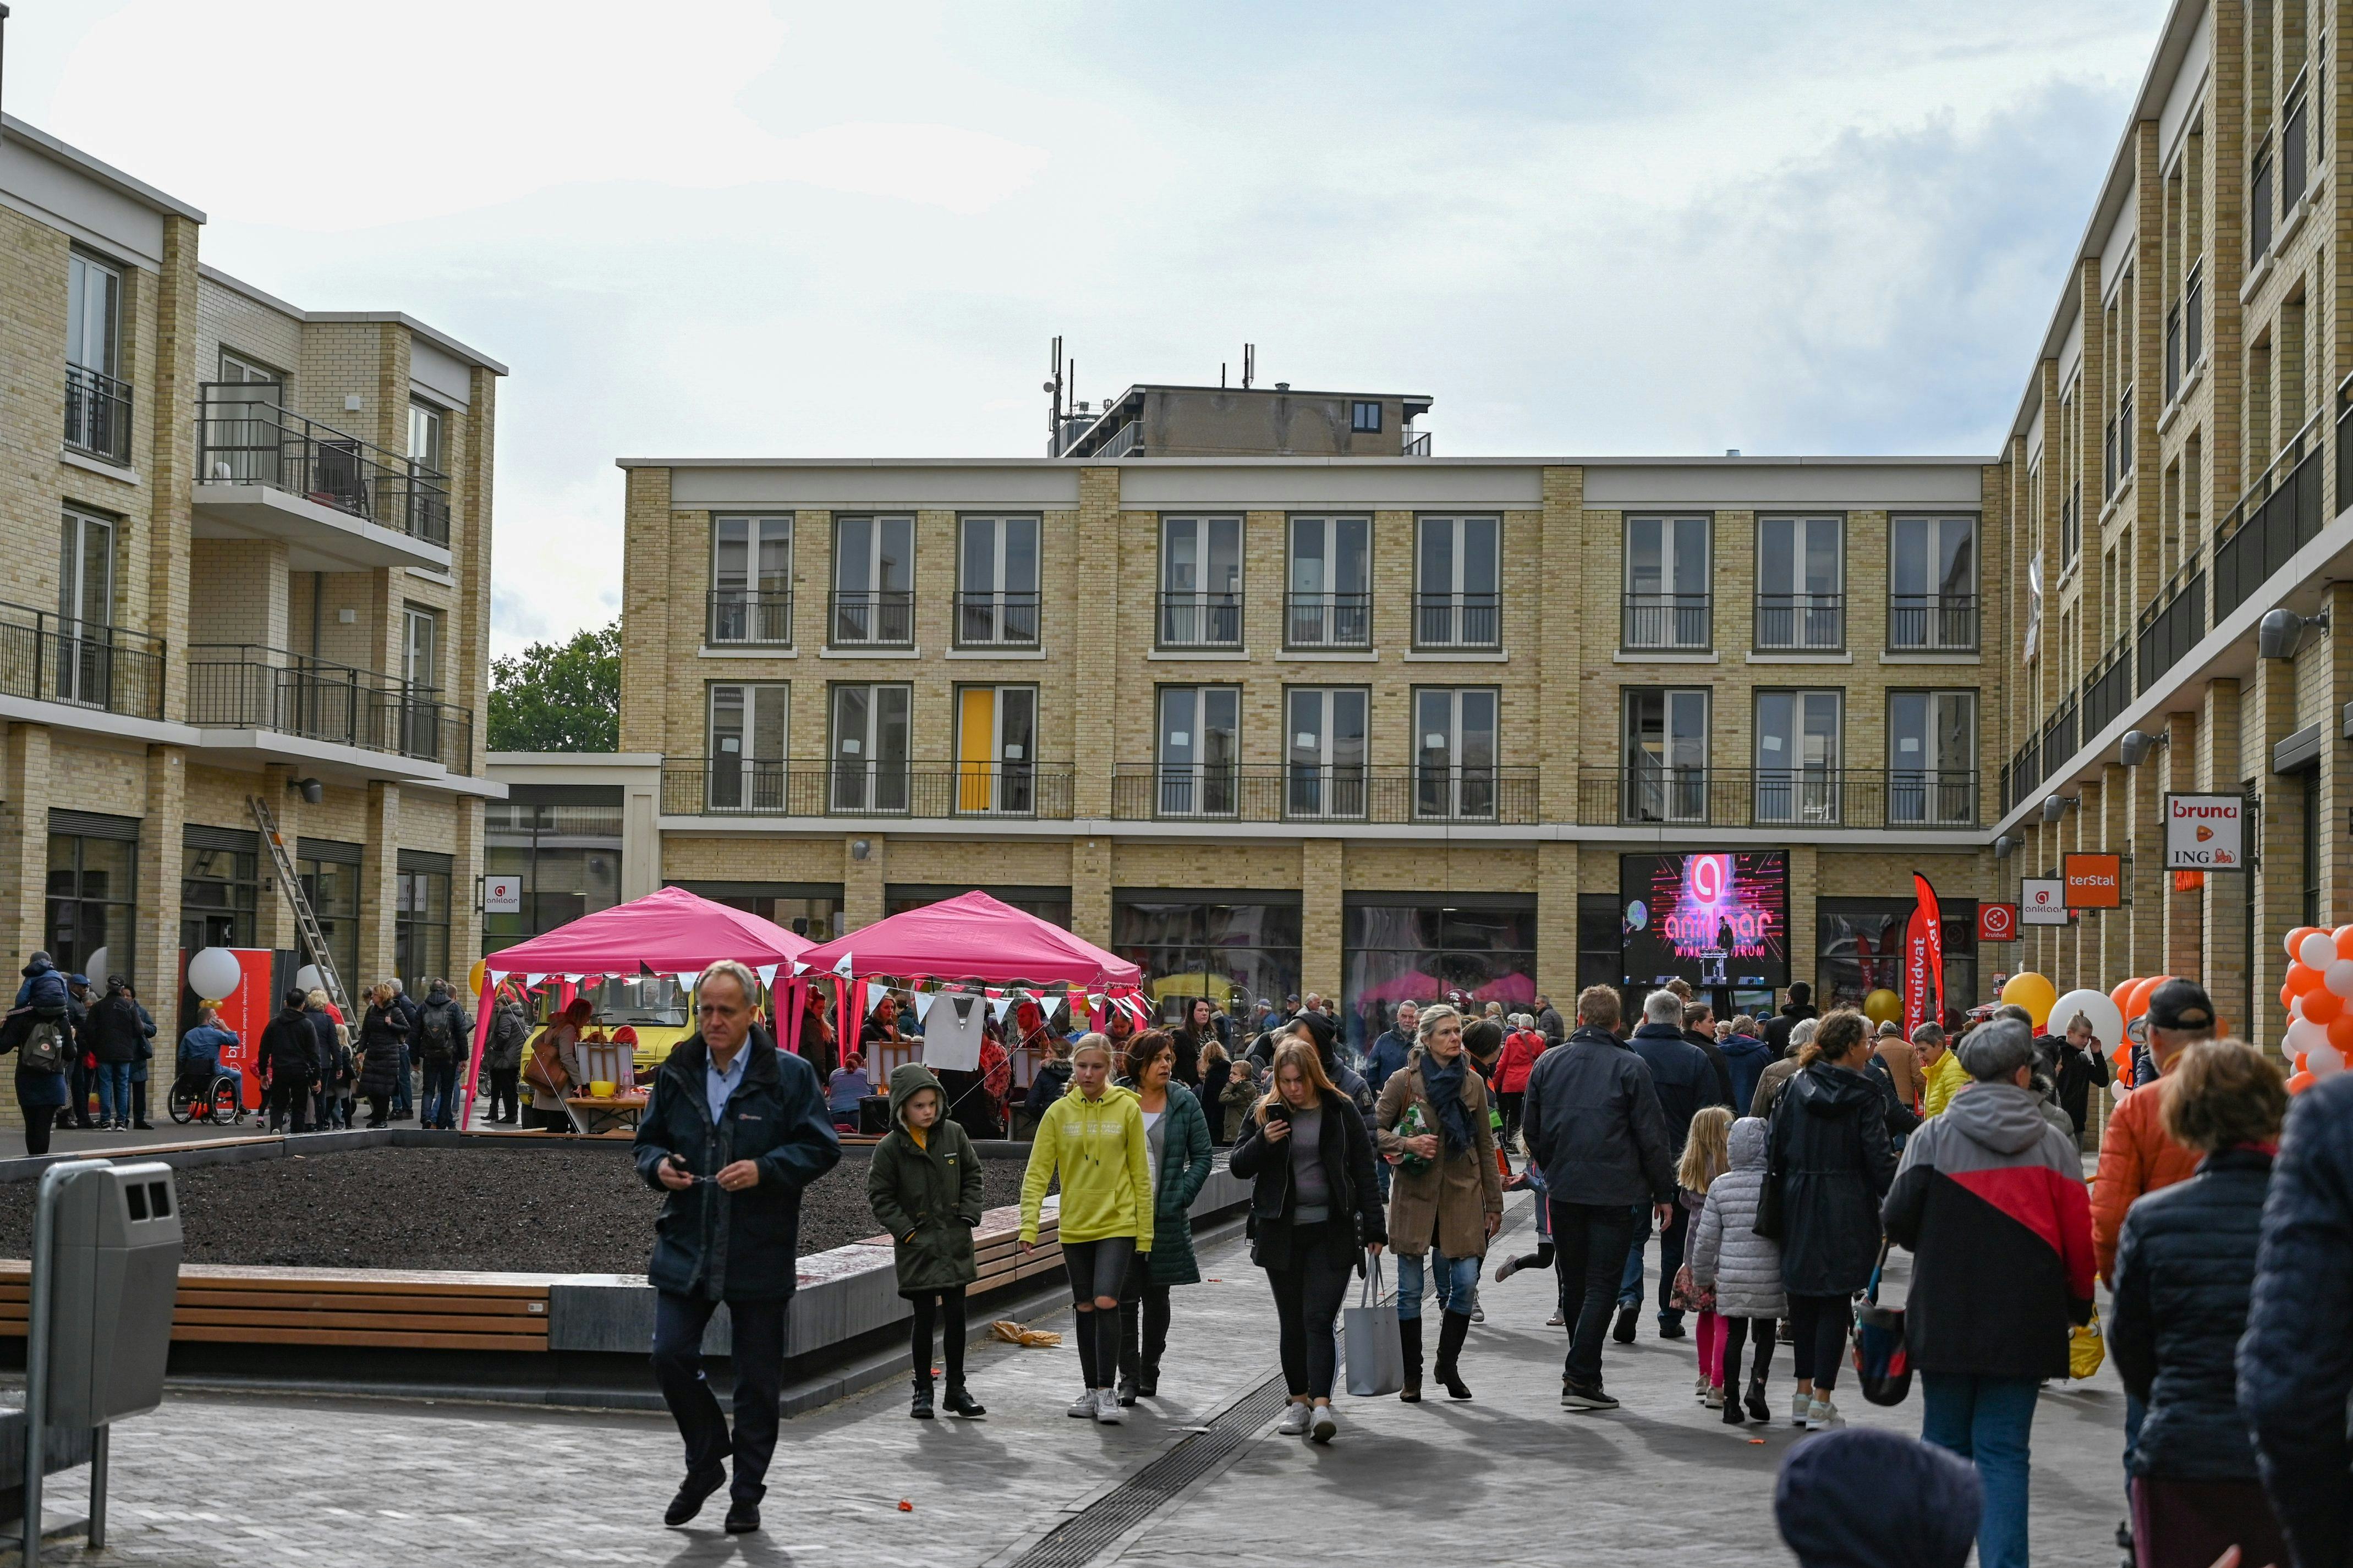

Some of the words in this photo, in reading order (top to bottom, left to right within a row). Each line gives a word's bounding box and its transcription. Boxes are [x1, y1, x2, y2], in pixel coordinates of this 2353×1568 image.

[2174, 800, 2237, 818] bruna
[2174, 851, 2210, 863] ING
[2070, 875, 2115, 886] terStal
[1674, 944, 1765, 959] WINKTRUM
[1911, 937, 1925, 1018] Kruidvat
